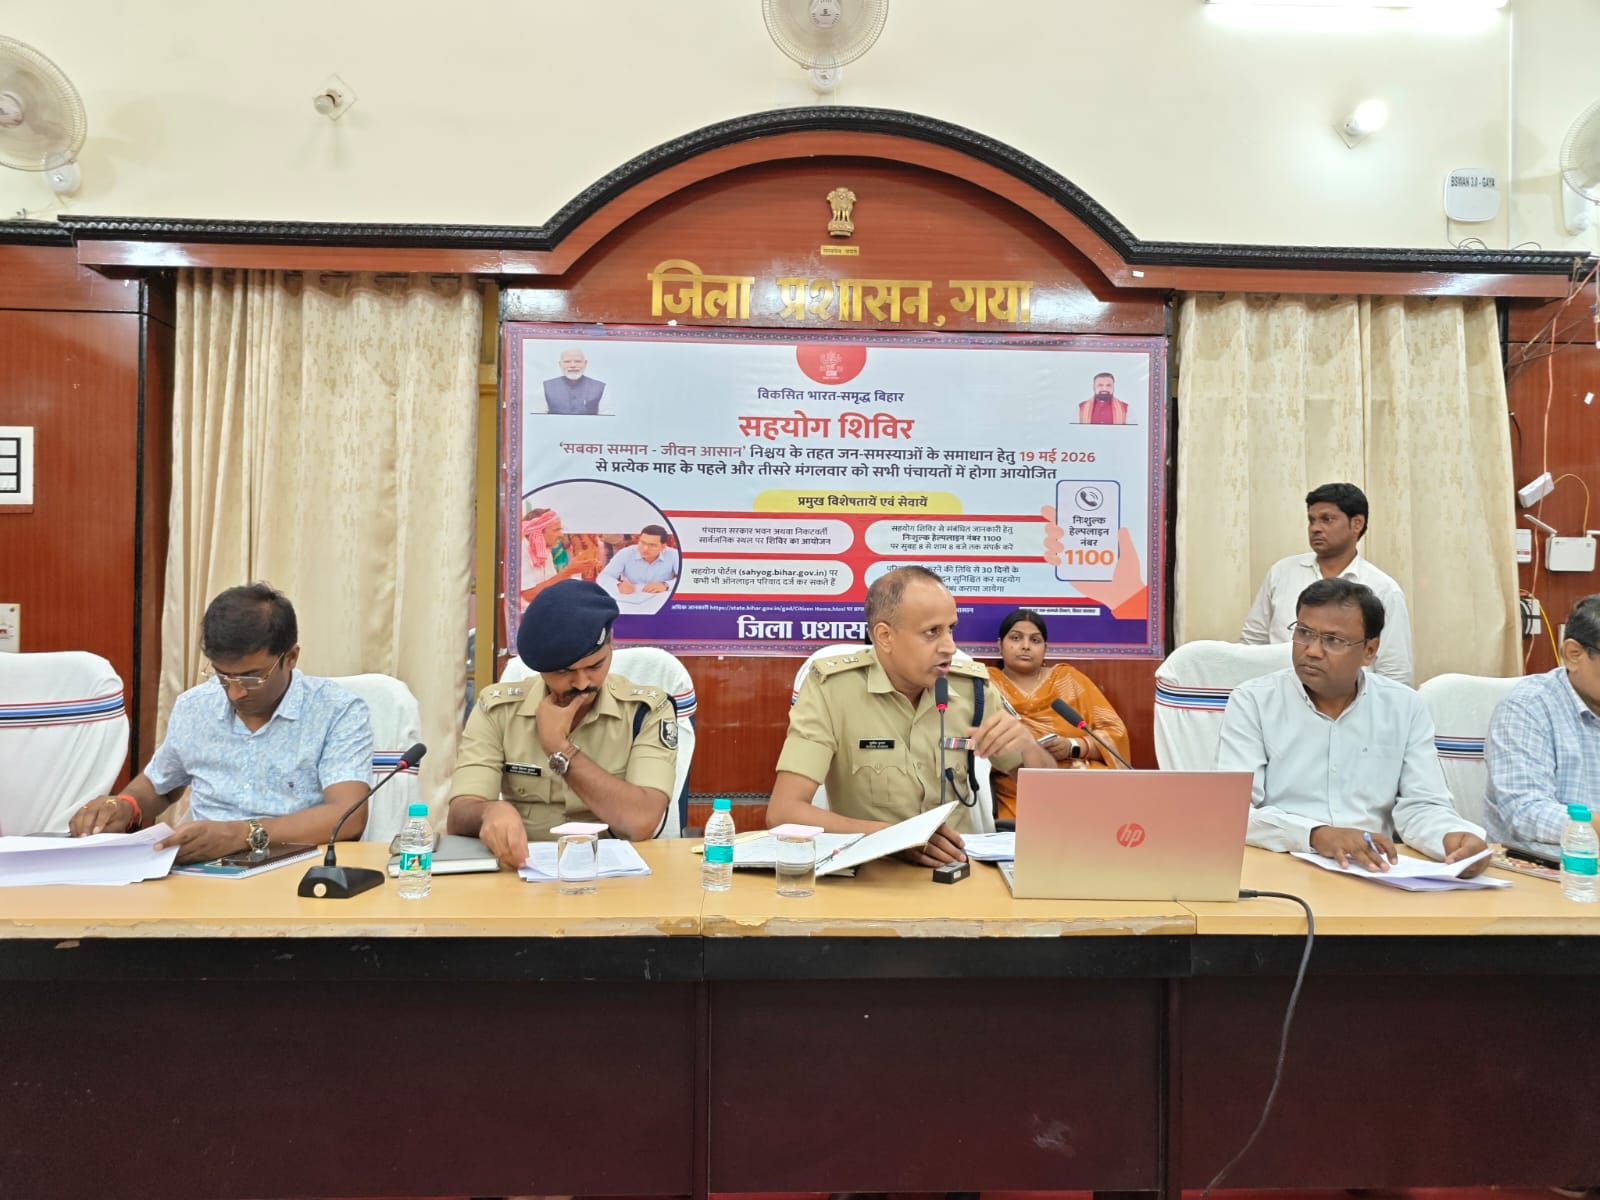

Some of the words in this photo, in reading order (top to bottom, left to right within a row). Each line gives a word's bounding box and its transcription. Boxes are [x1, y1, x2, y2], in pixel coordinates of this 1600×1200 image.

[647, 259, 755, 319] जिला
[776, 276, 946, 327] प्रशासन,
[949, 280, 1034, 323] गया
[758, 387, 804, 400] विकसित
[808, 390, 871, 404] भारत-समृद्ध
[874, 389, 905, 402] बिहार
[738, 410, 831, 440] सहयोग
[838, 411, 915, 439] शिविर
[607, 443, 648, 455] सम्मान
[660, 442, 696, 456] जीवन
[750, 444, 785, 458] निश्चय
[789, 444, 802, 458] के
[806, 448, 834, 460] तहत
[838, 446, 923, 460] जन-समस्याओं
[926, 447, 939, 460] के
[944, 449, 993, 461] समाधान
[997, 447, 1015, 465] हेतु
[1019, 451, 1034, 462] 19
[1039, 448, 1057, 463] मई
[1061, 452, 1096, 463] 2026
[595, 458, 607, 472] से
[612, 458, 649, 473] प्रत्येक
[653, 462, 676, 474] माह
[680, 460, 693, 473] के
[697, 460, 727, 475] पहले
[731, 460, 753, 475] और
[758, 462, 791, 475] तीसरे
[795, 463, 847, 477] मंगलवार
[851, 463, 869, 477] को
[872, 464, 900, 477] सभी
[904, 464, 951, 478] पंचायतों
[955, 464, 966, 478] में
[969, 465, 996, 480] होगा
[1000, 465, 1057, 479] आयोजित
[798, 496, 824, 509] प्रमुख
[880, 495, 895, 507] एवं
[898, 495, 928, 507] सेवायें
[702, 526, 726, 534] पंचायत
[795, 527, 828, 535] निकटवर्ती
[891, 524, 915, 532] सहयोग
[916, 524, 936, 532] शिविर
[938, 524, 945, 532] से
[972, 524, 1001, 533] जानकारी
[1002, 524, 1013, 535] हेतु
[1068, 526, 1110, 537] हेल्पलाइन
[699, 535, 735, 543] सार्वजनिक
[736, 536, 753, 544] स्थल
[766, 536, 788, 545] शिविर
[789, 537, 799, 545] का
[801, 536, 831, 545] आयोजन
[932, 533, 965, 542] हेल्पलाइन
[1080, 537, 1098, 546] नंबर
[901, 543, 917, 551] सुबह
[983, 543, 1001, 551] संपर्क
[1064, 550, 1114, 566] 1100
[691, 567, 716, 575] सहयोग
[717, 566, 737, 575] पोर्टल
[738, 568, 827, 578] (sahyog.bihar.gov.in)
[829, 569, 839, 577] पर
[944, 565, 953, 573] की
[955, 565, 971, 573] तिथि
[973, 565, 980, 573] से
[693, 576, 709, 584] कभी
[712, 576, 720, 584] भी
[757, 577, 780, 586] परिवाद
[783, 577, 794, 586] दर्ज
[809, 577, 828, 586] सकते
[996, 575, 1020, 584] सहयोग
[982, 585, 1005, 593] जायेगा
[736, 614, 793, 639] जिला
[800, 621, 868, 640] प्रशास
[1117, 822, 1145, 848] hp
